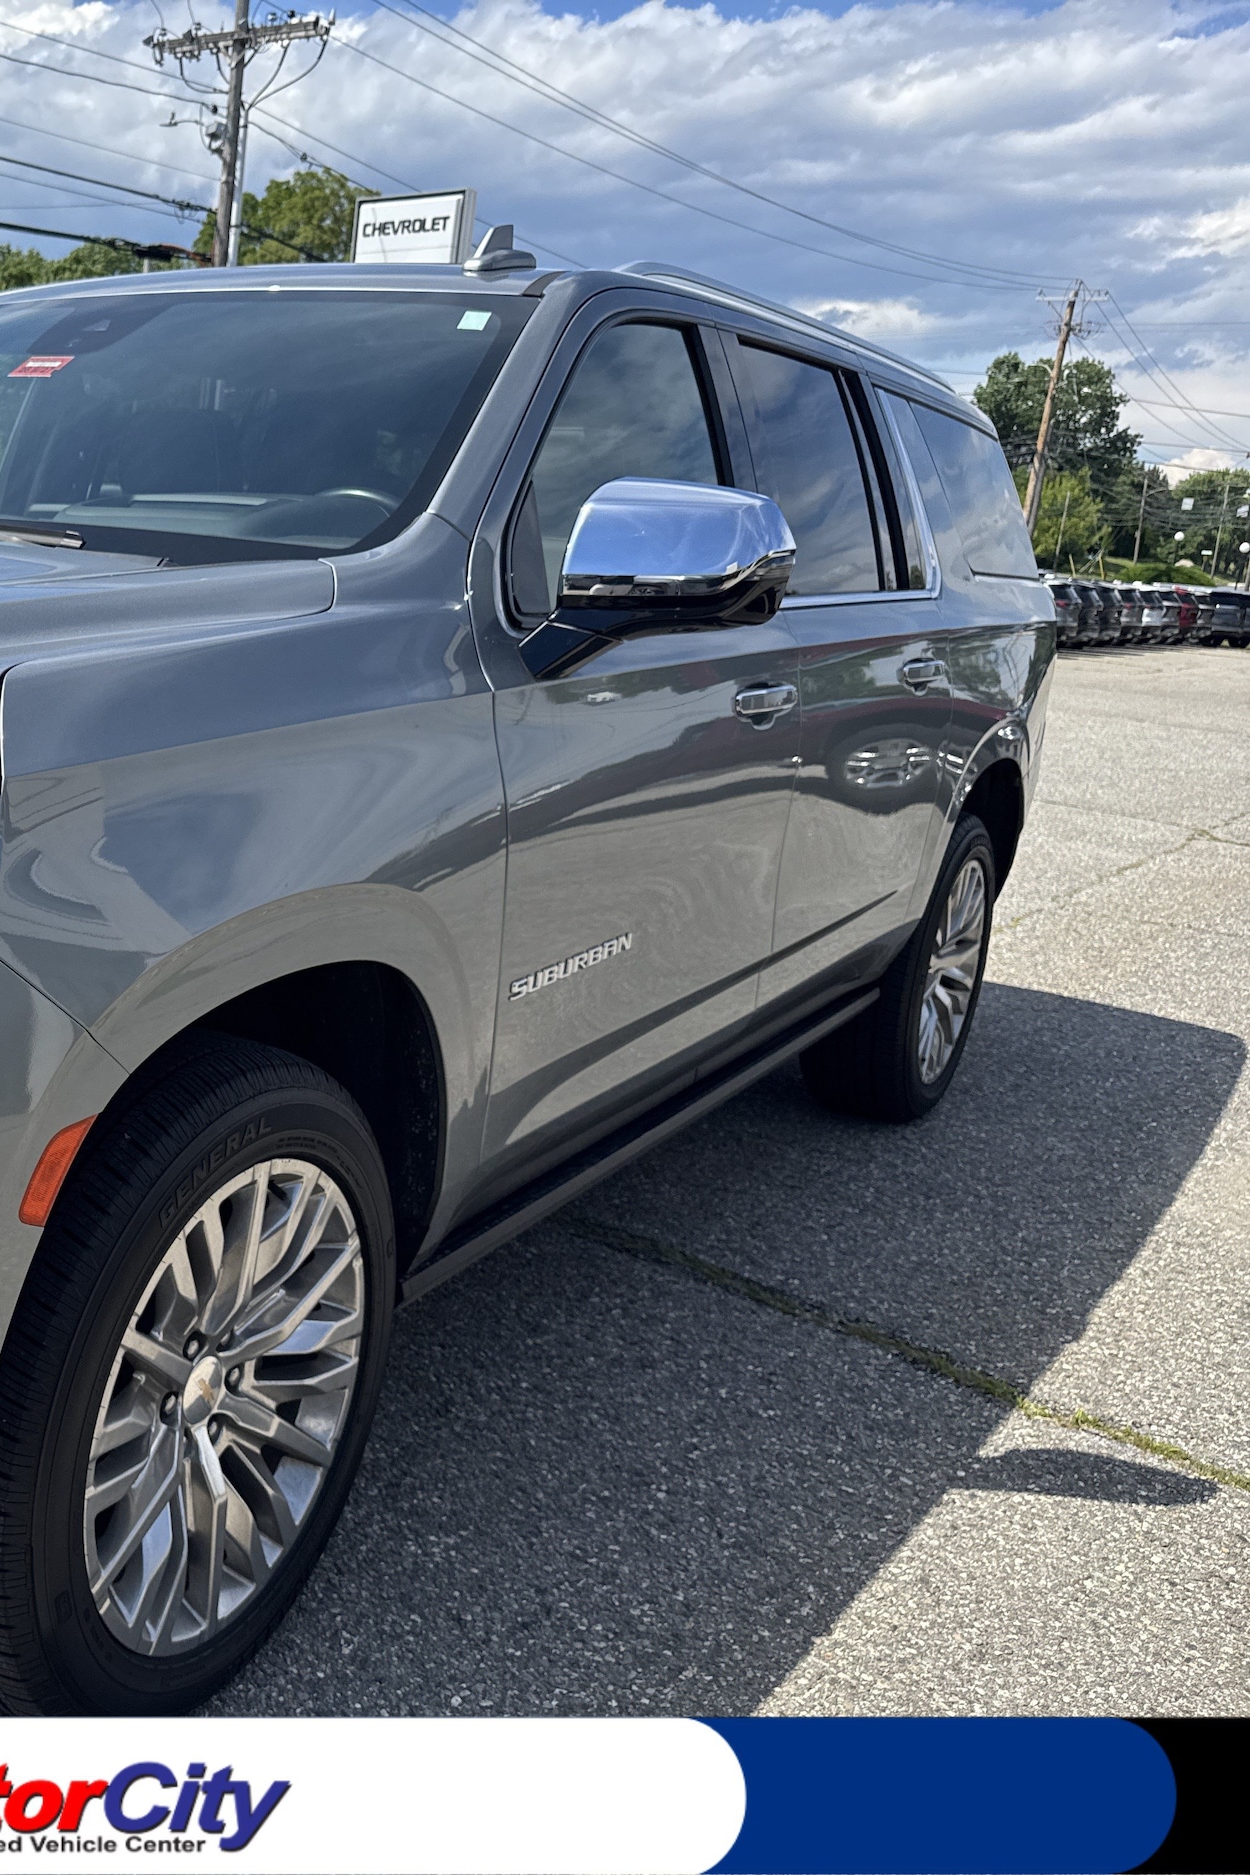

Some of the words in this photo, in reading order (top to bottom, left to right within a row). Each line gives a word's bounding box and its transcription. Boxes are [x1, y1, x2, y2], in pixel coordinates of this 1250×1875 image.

[362, 216, 450, 238] CHEVROLET
[508, 932, 633, 1001] SUBURBAN
[158, 1117, 273, 1228] GENERAL
